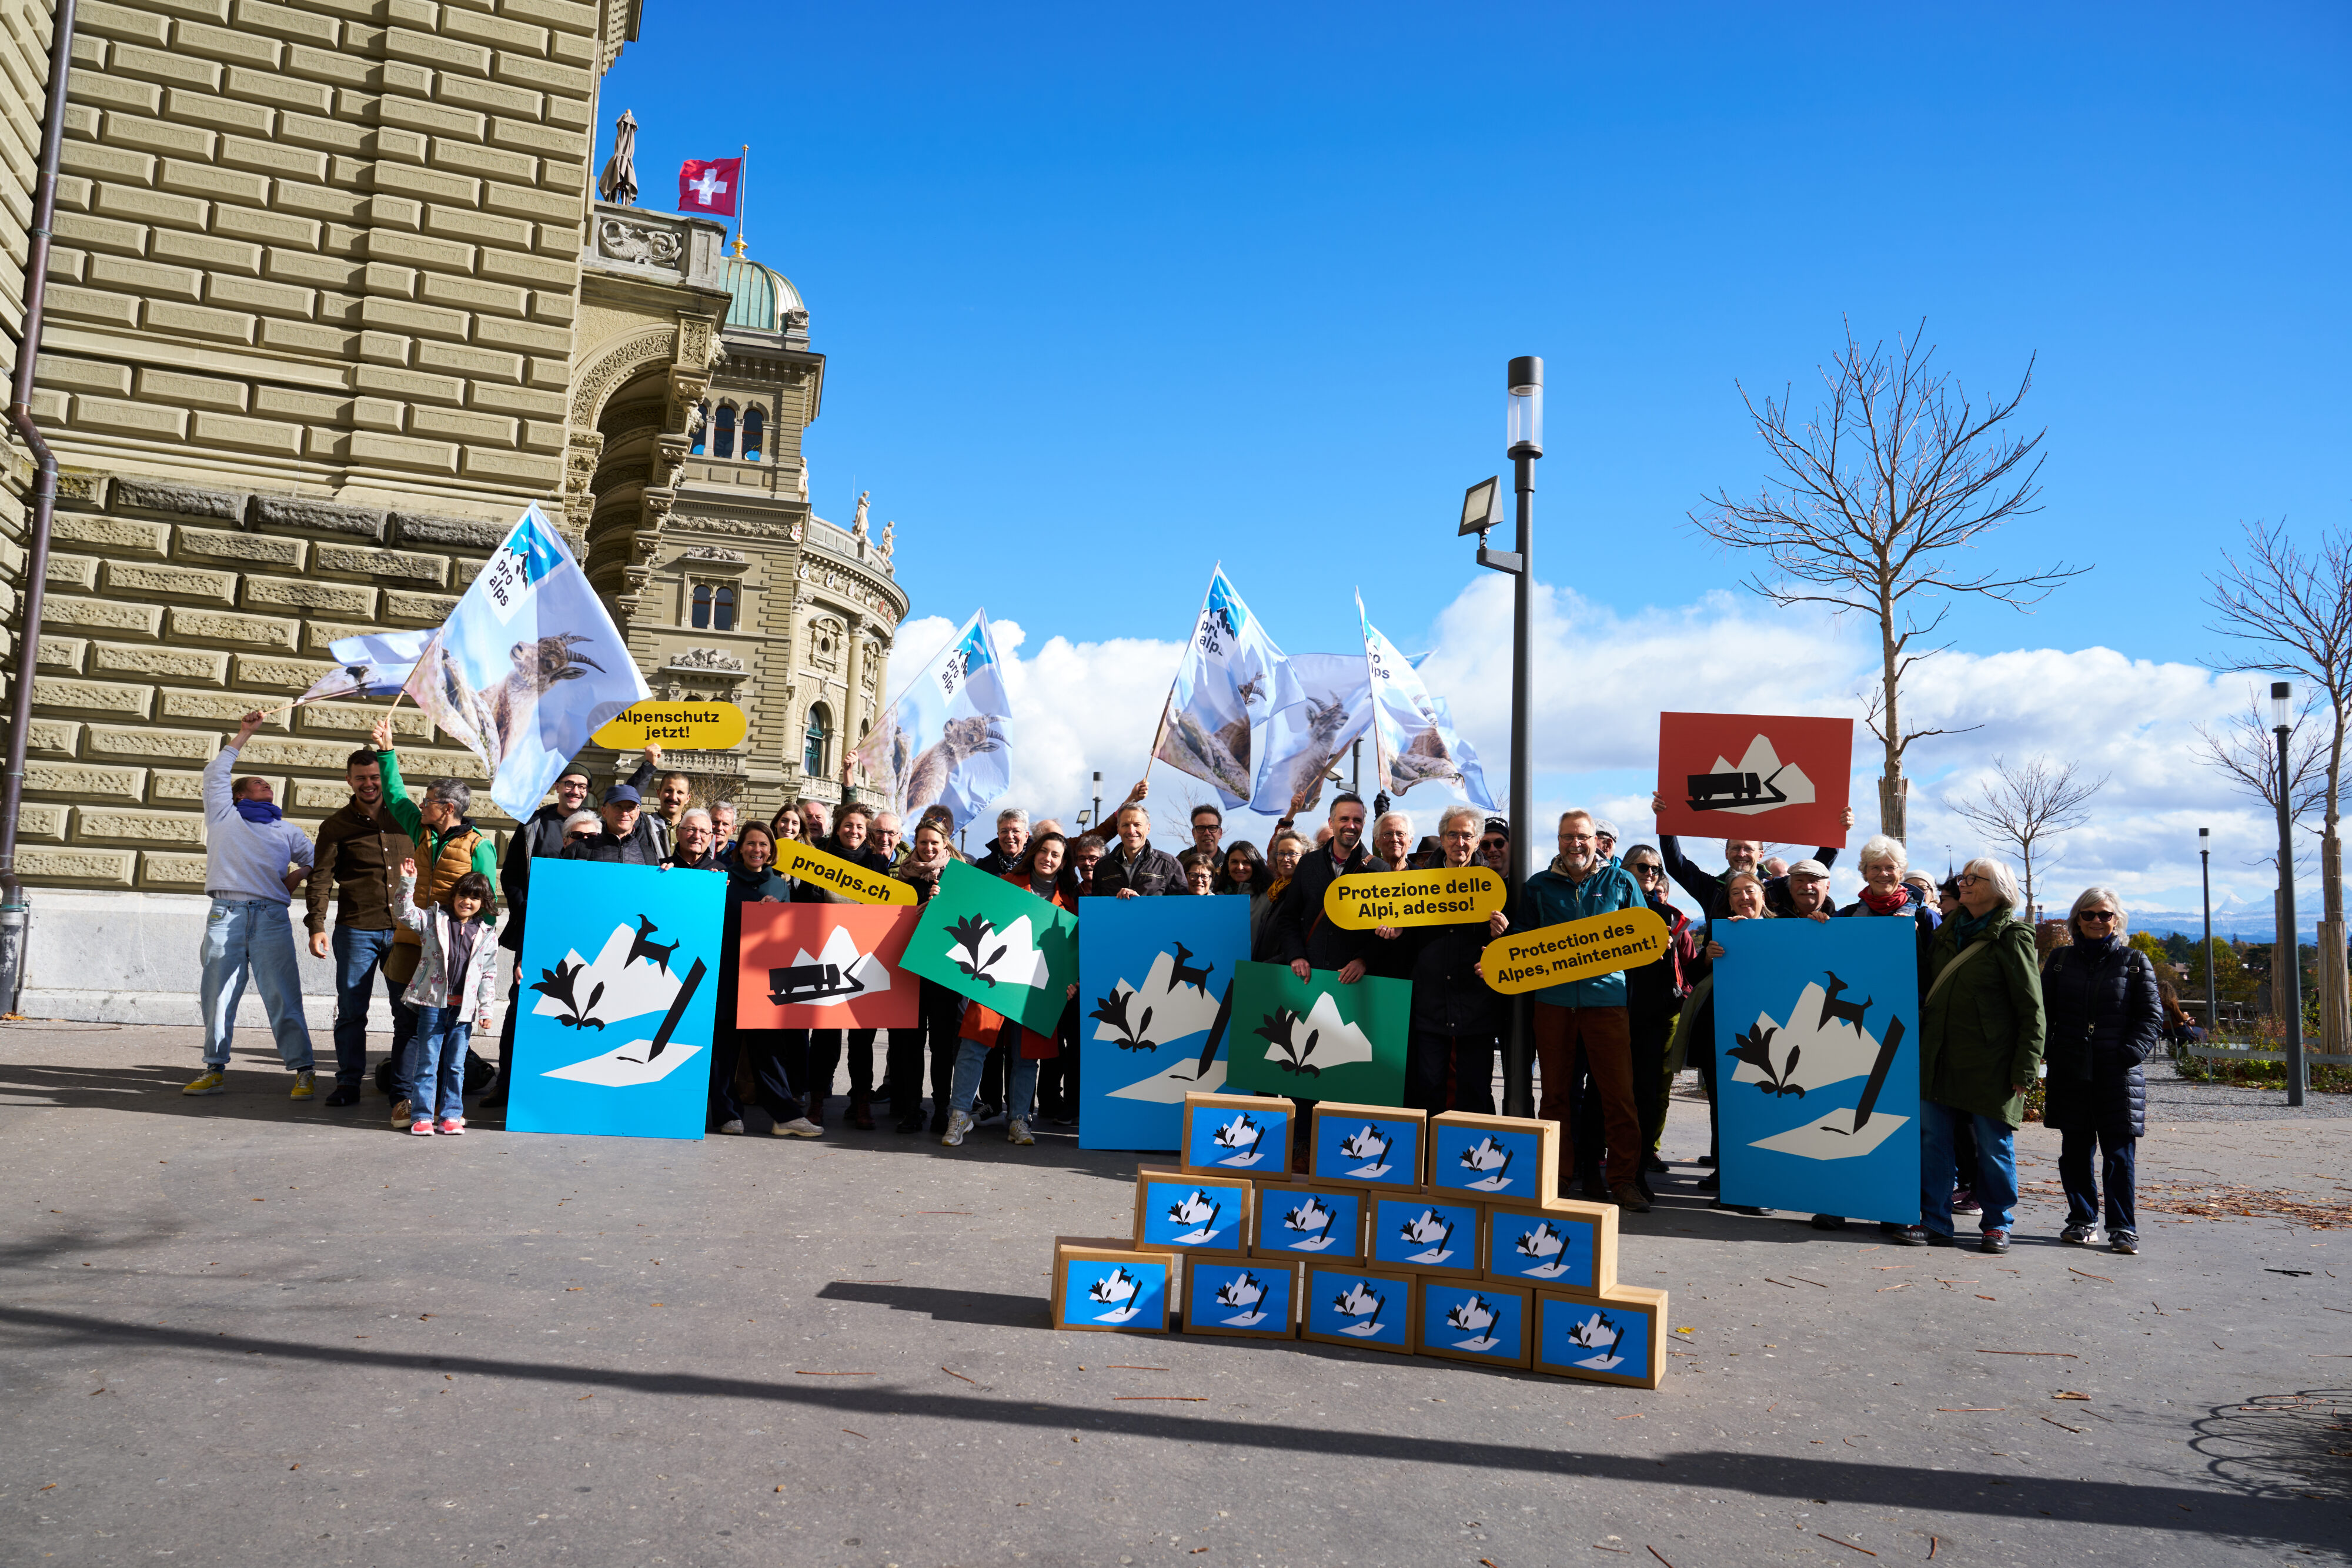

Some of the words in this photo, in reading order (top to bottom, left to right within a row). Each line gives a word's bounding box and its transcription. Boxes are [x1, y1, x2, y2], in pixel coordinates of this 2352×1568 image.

[496, 559, 513, 586] pro
[489, 576, 509, 607] alps
[1200, 636, 1223, 657] alp
[1369, 651, 1381, 664] ro
[947, 658, 959, 678] pro
[1371, 662, 1390, 679] lps
[942, 671, 954, 694] alps
[616, 710, 719, 725] Alpenschutz
[645, 726, 689, 741] jetzt!
[791, 856, 890, 901] proalps.ch
[1338, 882, 1441, 900] Protezione
[1446, 878, 1492, 894] delle
[1358, 902, 1399, 920] Alpi,
[1404, 897, 1474, 914] adesso!
[1509, 932, 1599, 961] Protection
[1603, 924, 1635, 939] des
[1498, 964, 1549, 983] Alpes,
[1552, 935, 1658, 971] maintenant!
